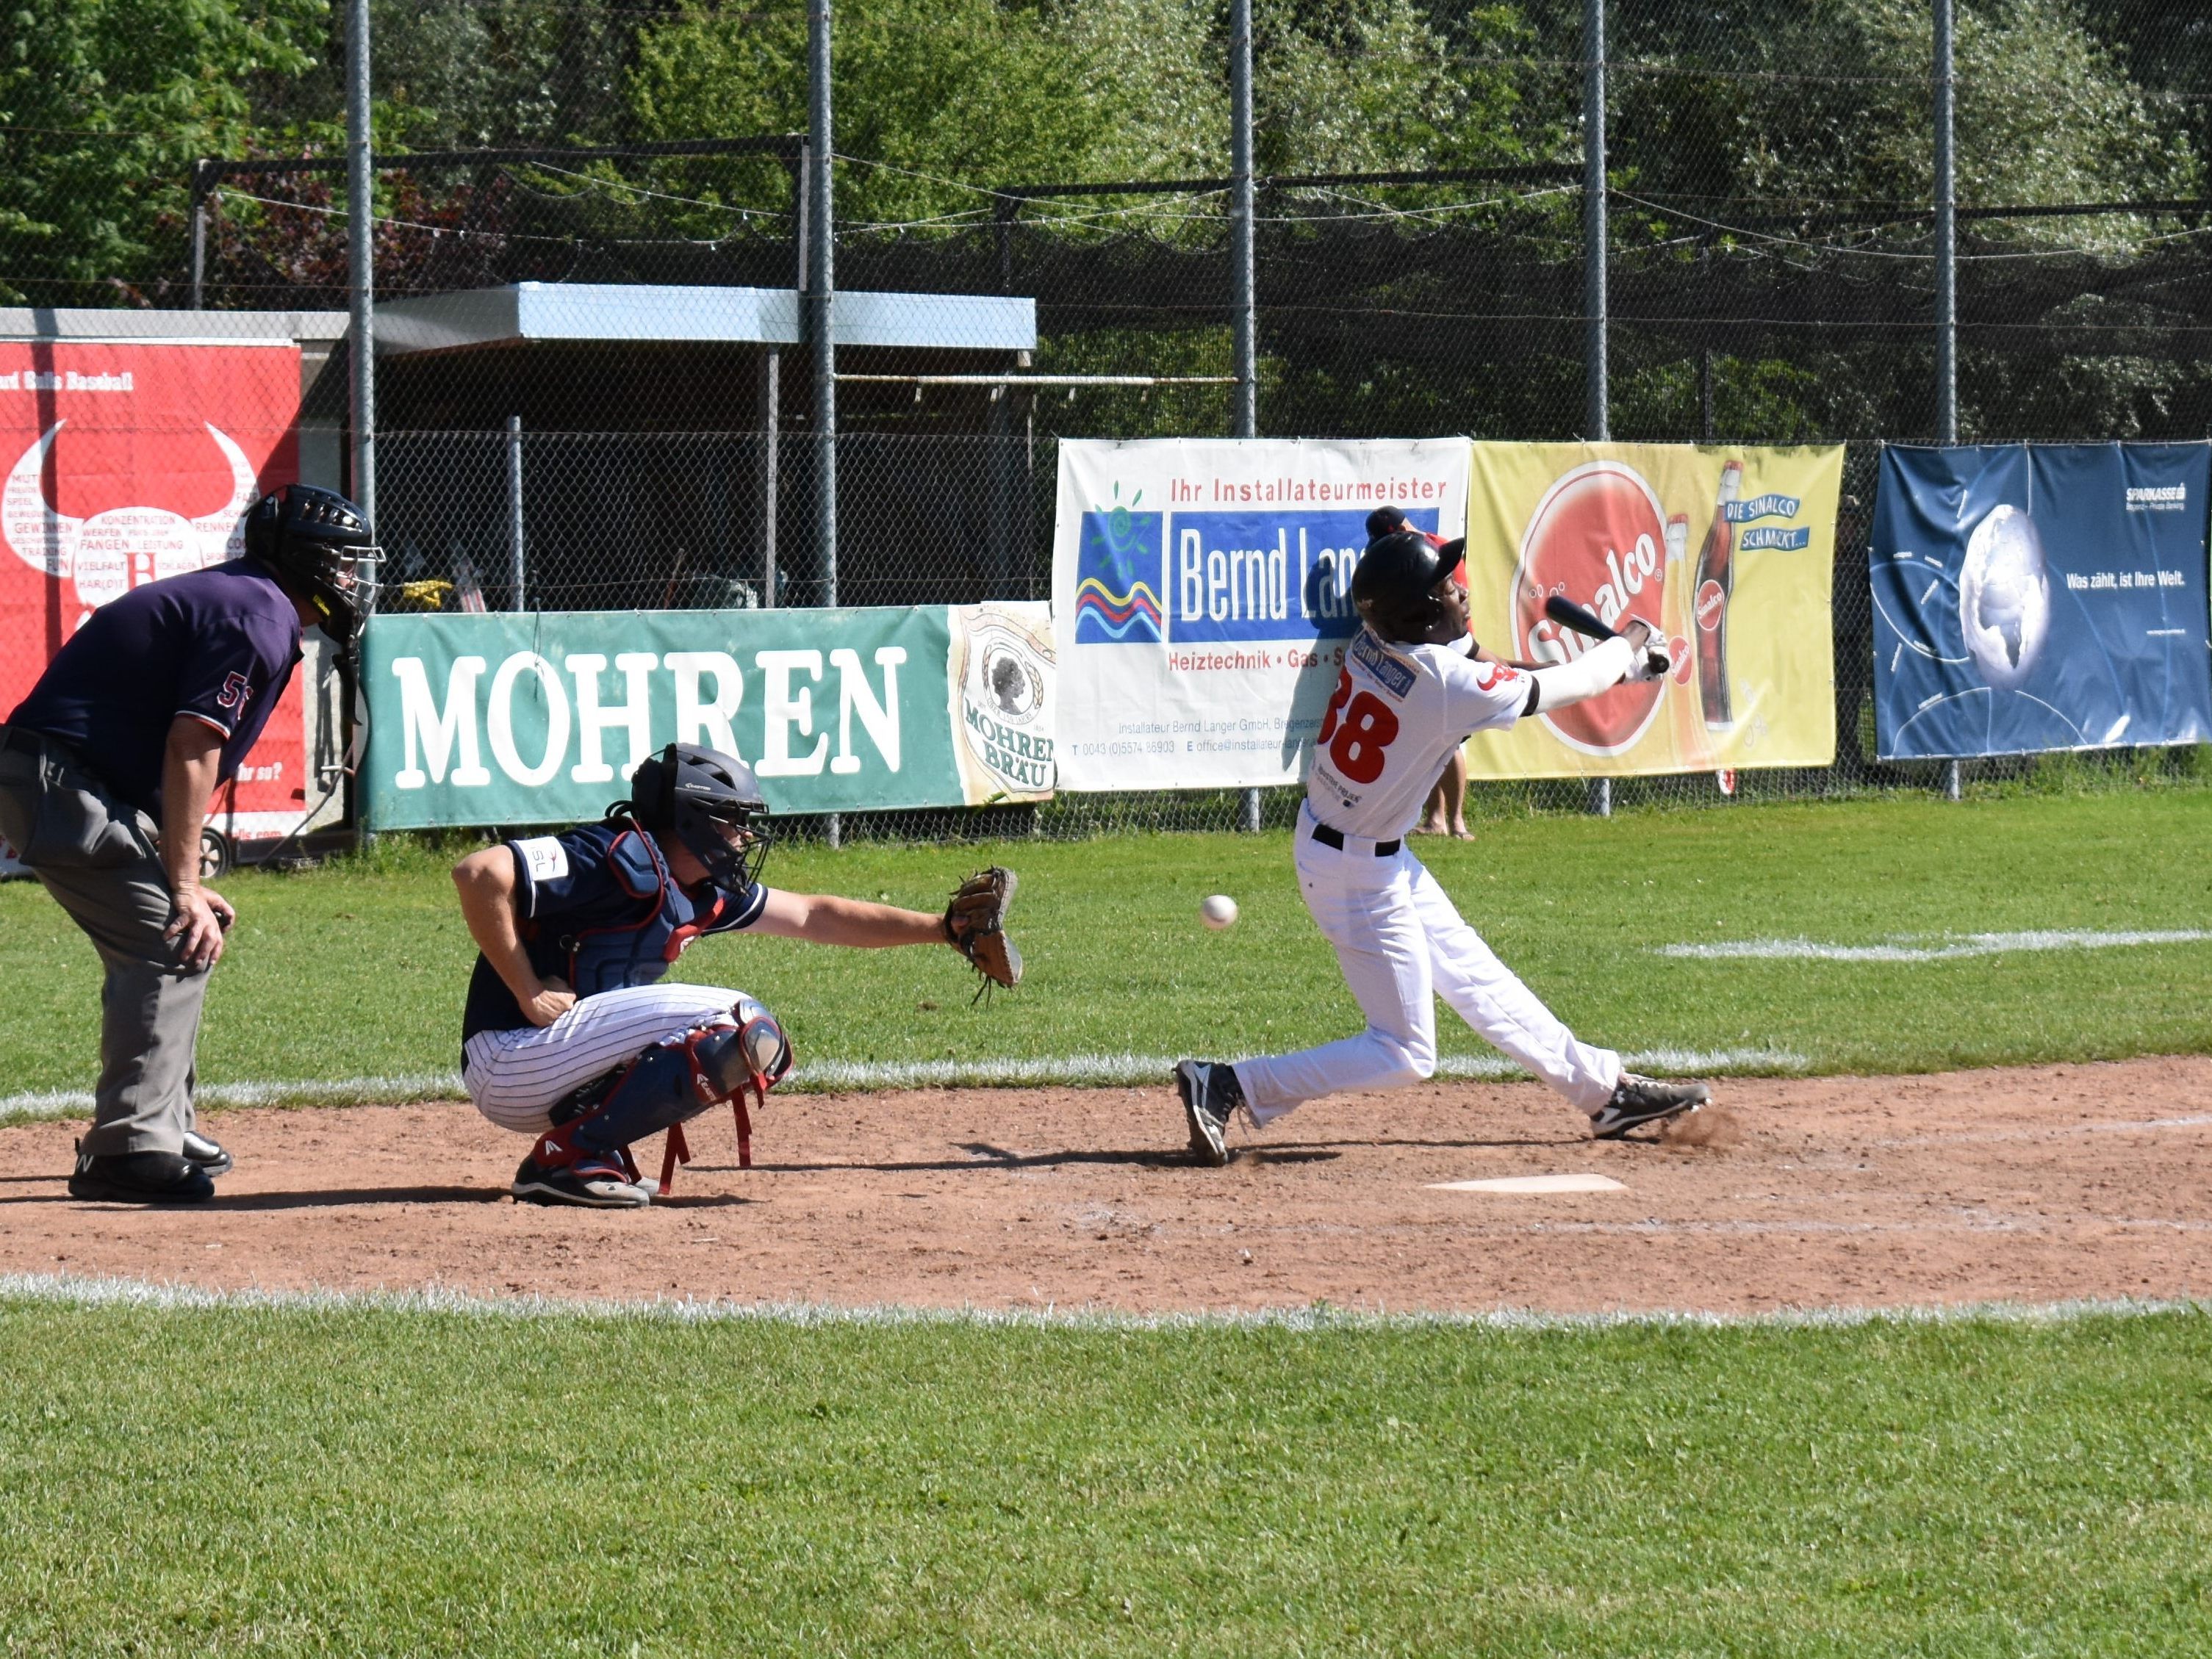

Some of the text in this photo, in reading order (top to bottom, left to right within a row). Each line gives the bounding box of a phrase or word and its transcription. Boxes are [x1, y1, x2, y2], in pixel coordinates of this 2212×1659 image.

[24, 370, 62, 390] Bulls
[66, 370, 134, 391] Baseball
[12, 475, 37, 483] MUT
[1171, 476, 1446, 502] Ihr Installateurmeister
[2126, 486, 2177, 501] SPARKASSE
[1727, 497, 1795, 519] DIE SINALCO
[15, 522, 72, 533] GEWINNEN
[101, 515, 176, 525] KONZENTRATION
[195, 522, 239, 533] RENNEN
[83, 528, 121, 536] WERFEN
[80, 539, 184, 550] FANGEN LEISTUNG
[78, 561, 126, 570] VIELFALT
[1180, 527, 1365, 622] Bernd Lan
[2066, 570, 2186, 589] Was zählt, ist Ihre Welt.
[1168, 649, 1271, 671] Heiztechnik
[1288, 649, 1318, 668] Gas
[1354, 633, 1379, 666] Bernd
[1376, 654, 1407, 689] Langer
[392, 647, 908, 789] MOHREN
[1118, 721, 1169, 734] Installateur
[1173, 720, 1201, 733] Bernd
[1204, 719, 1236, 734] Langer
[1239, 719, 1271, 732] GmbH,
[964, 696, 1055, 761] MOHREN
[1072, 744, 1078, 756] T
[1083, 743, 1107, 756] 0043
[1109, 741, 1143, 757] (0)5574
[1187, 741, 1193, 752] E
[256, 761, 283, 781] so?
[983, 739, 1047, 787] BRÄU
